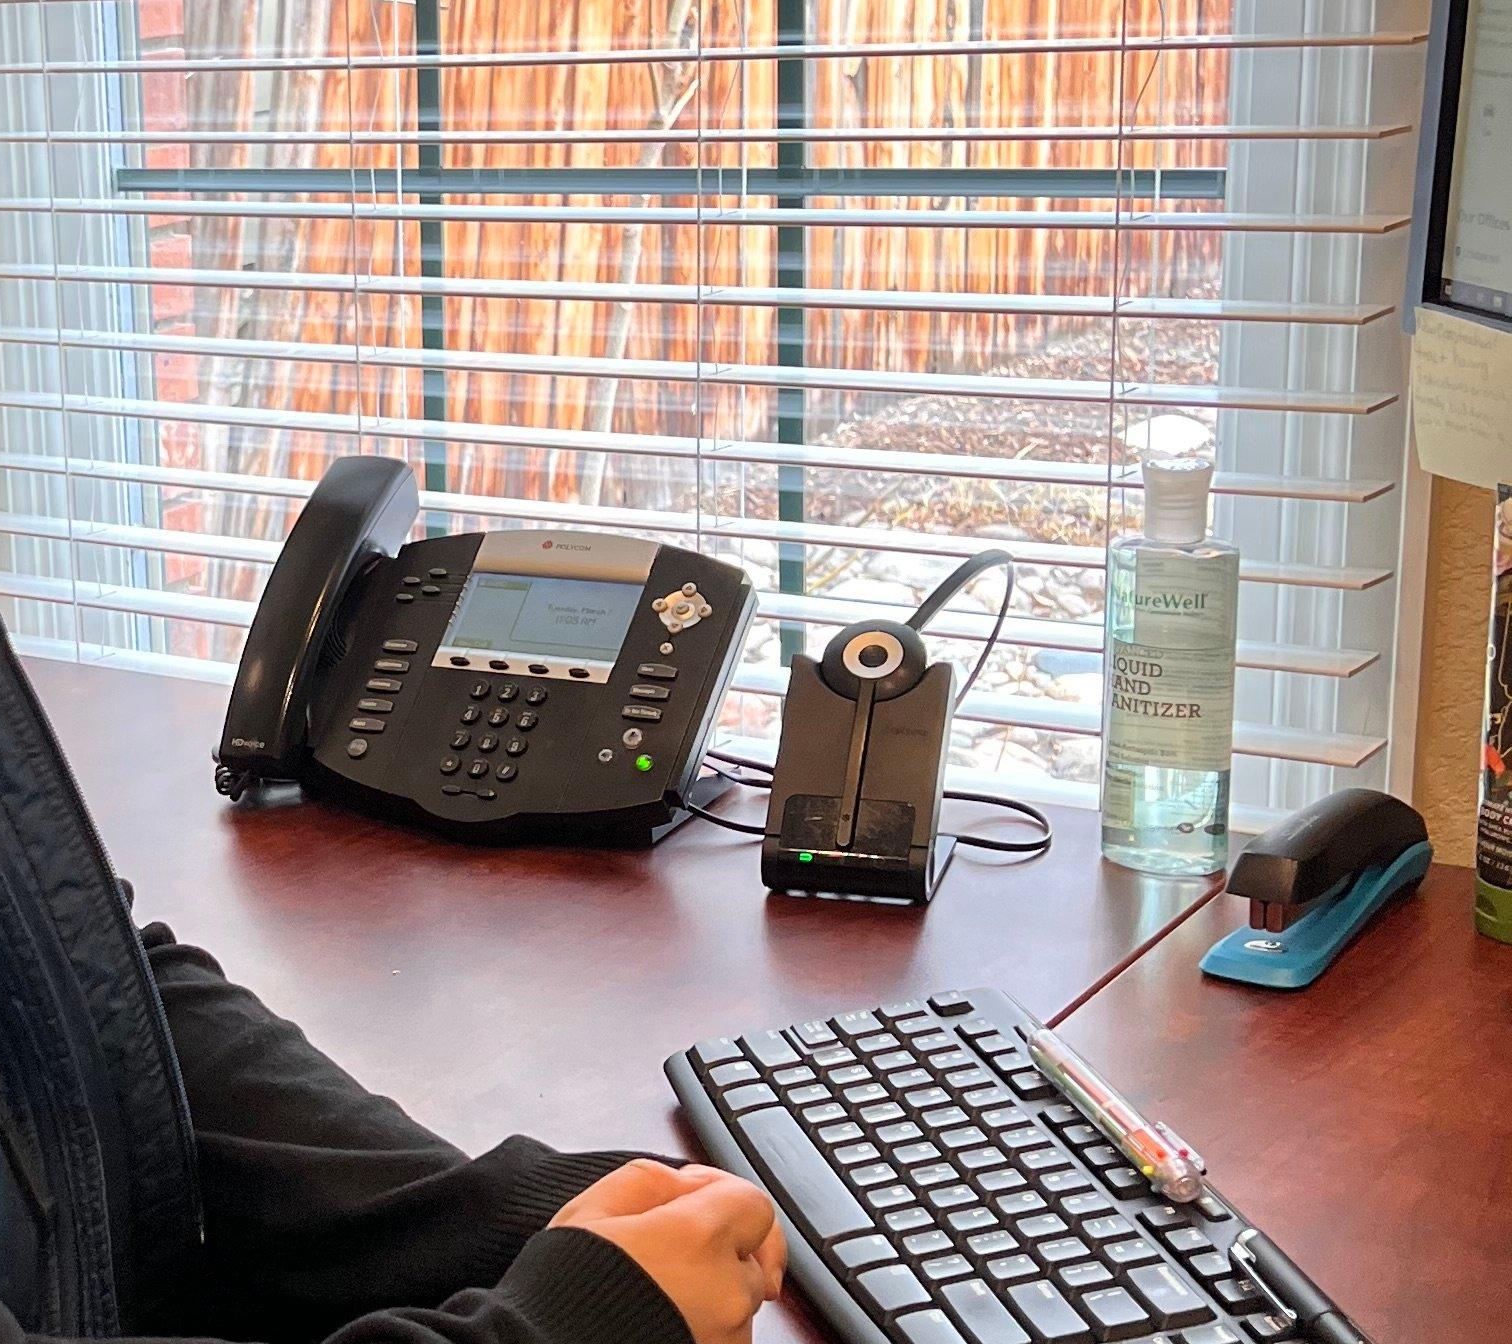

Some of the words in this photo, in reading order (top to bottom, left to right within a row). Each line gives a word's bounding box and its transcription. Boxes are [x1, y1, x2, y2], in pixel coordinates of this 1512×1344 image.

[555, 542, 593, 552] POLYCOM
[1114, 588, 1207, 610] NatureWell
[1113, 655, 1163, 678] IQUID
[1112, 675, 1151, 696] AND
[1111, 693, 1203, 719] ANITIZER
